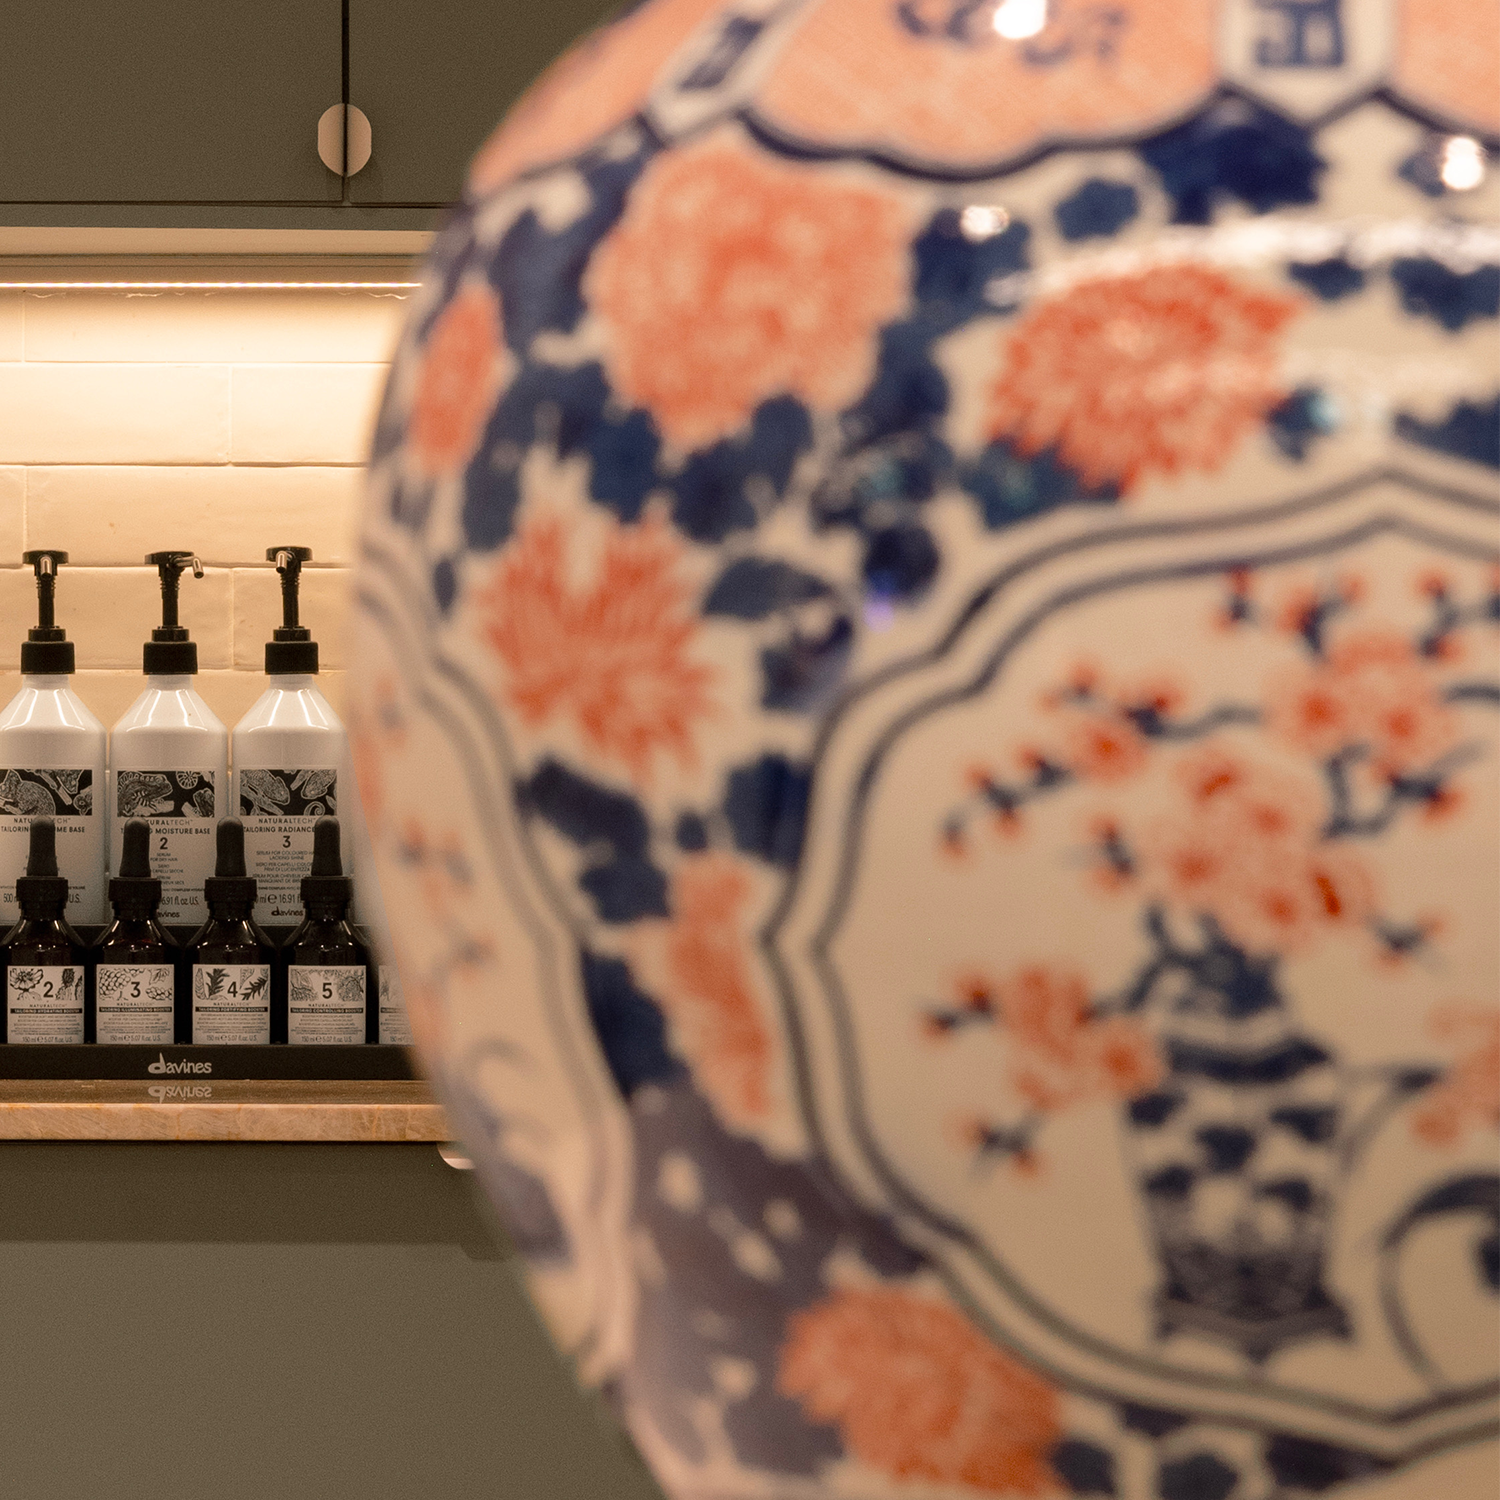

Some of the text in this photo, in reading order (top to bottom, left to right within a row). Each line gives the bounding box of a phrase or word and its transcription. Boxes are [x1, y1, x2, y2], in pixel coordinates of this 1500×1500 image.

[160, 837, 168, 850] 2
[283, 835, 291, 848] 3
[271, 906, 303, 916] davines
[43, 981, 53, 998] 2
[130, 982, 141, 998] 3
[227, 982, 238, 998] 4
[322, 983, 332, 999] 5
[148, 1052, 212, 1074] davines
